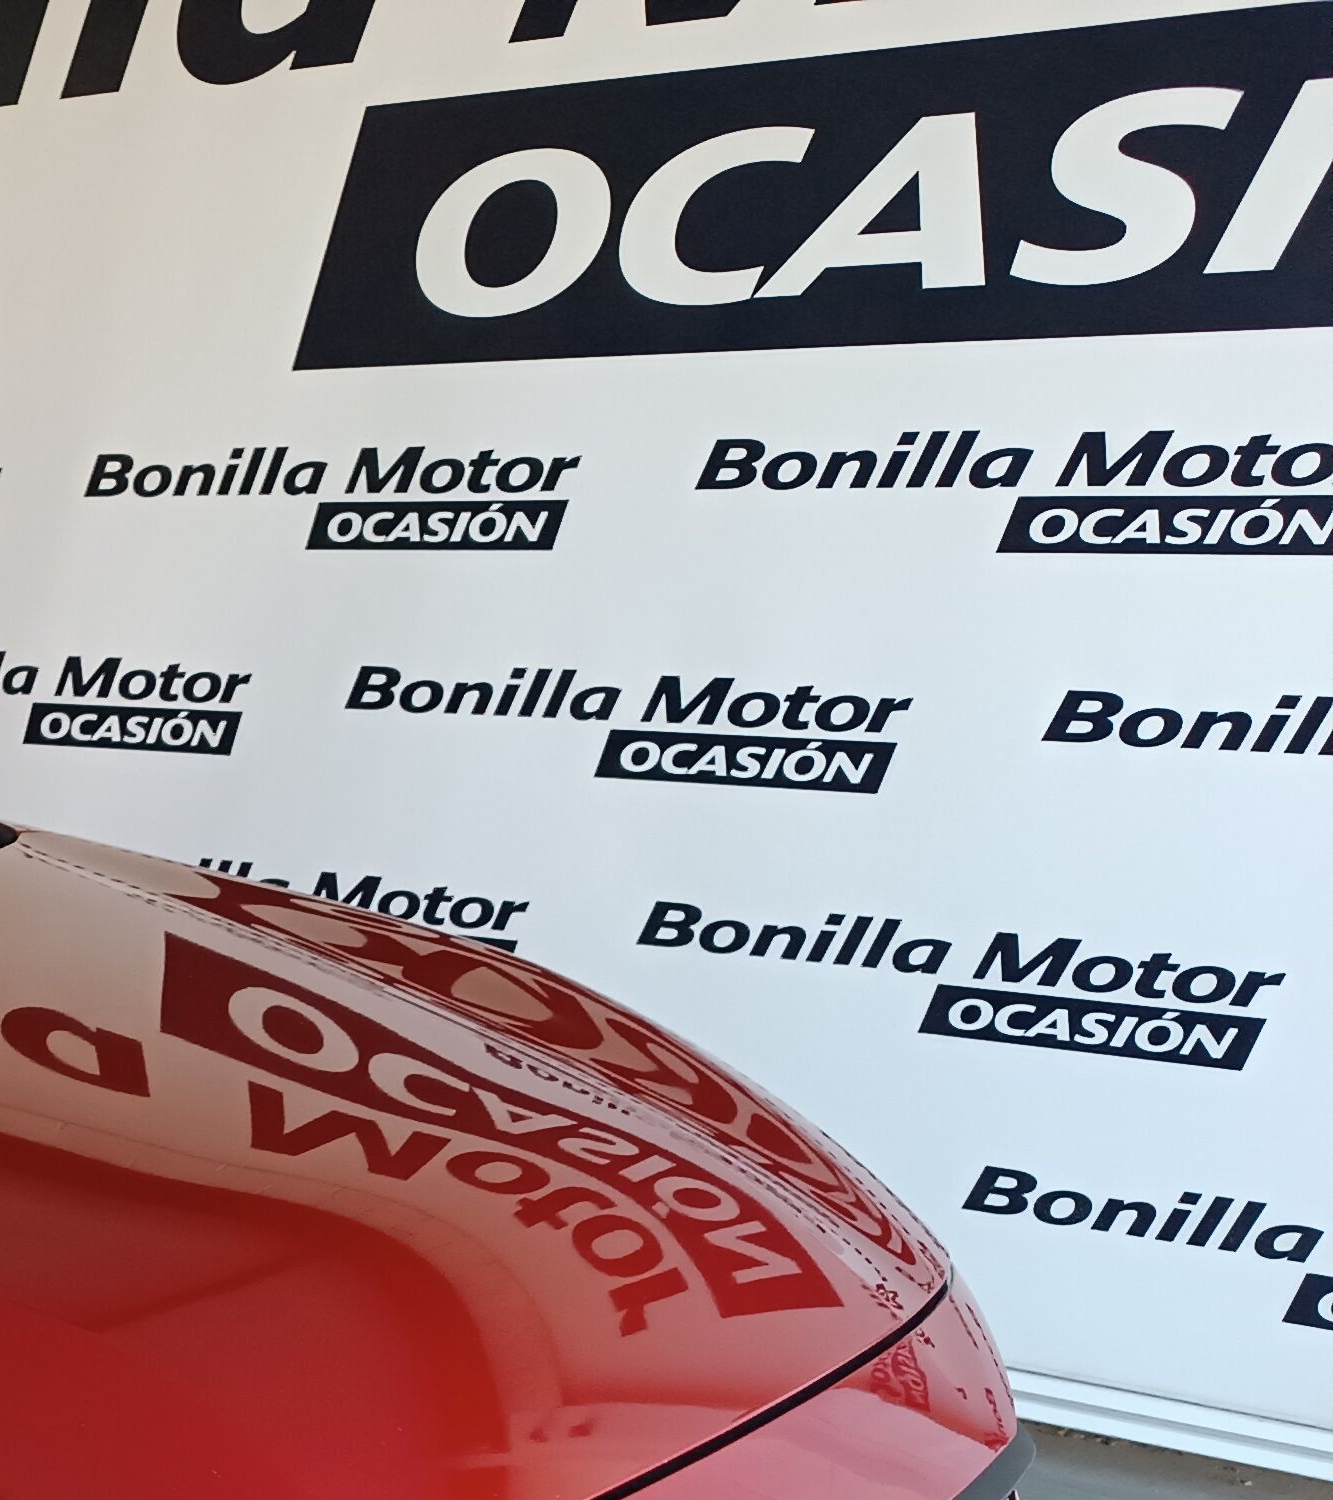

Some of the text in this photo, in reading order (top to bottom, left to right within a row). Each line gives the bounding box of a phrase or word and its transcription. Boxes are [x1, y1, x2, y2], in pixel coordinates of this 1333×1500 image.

[84, 445, 582, 498] Bonilla Motor
[694, 430, 1034, 491] Bonilla
[326, 503, 551, 544] OCASIÓN
[1028, 498, 1333, 546] OCASIÓN
[54, 655, 252, 704] Motor
[344, 664, 913, 734] Bonilla Motor
[39, 709, 228, 750] OCASIÓN
[1041, 689, 1333, 756] Bonil
[618, 741, 875, 786] OCASIÓN
[311, 871, 531, 931] Motor
[636, 899, 1286, 1008] Bonilla Motor
[947, 997, 1239, 1060] OCASIÓN
[961, 1165, 1325, 1264] Bonilla
